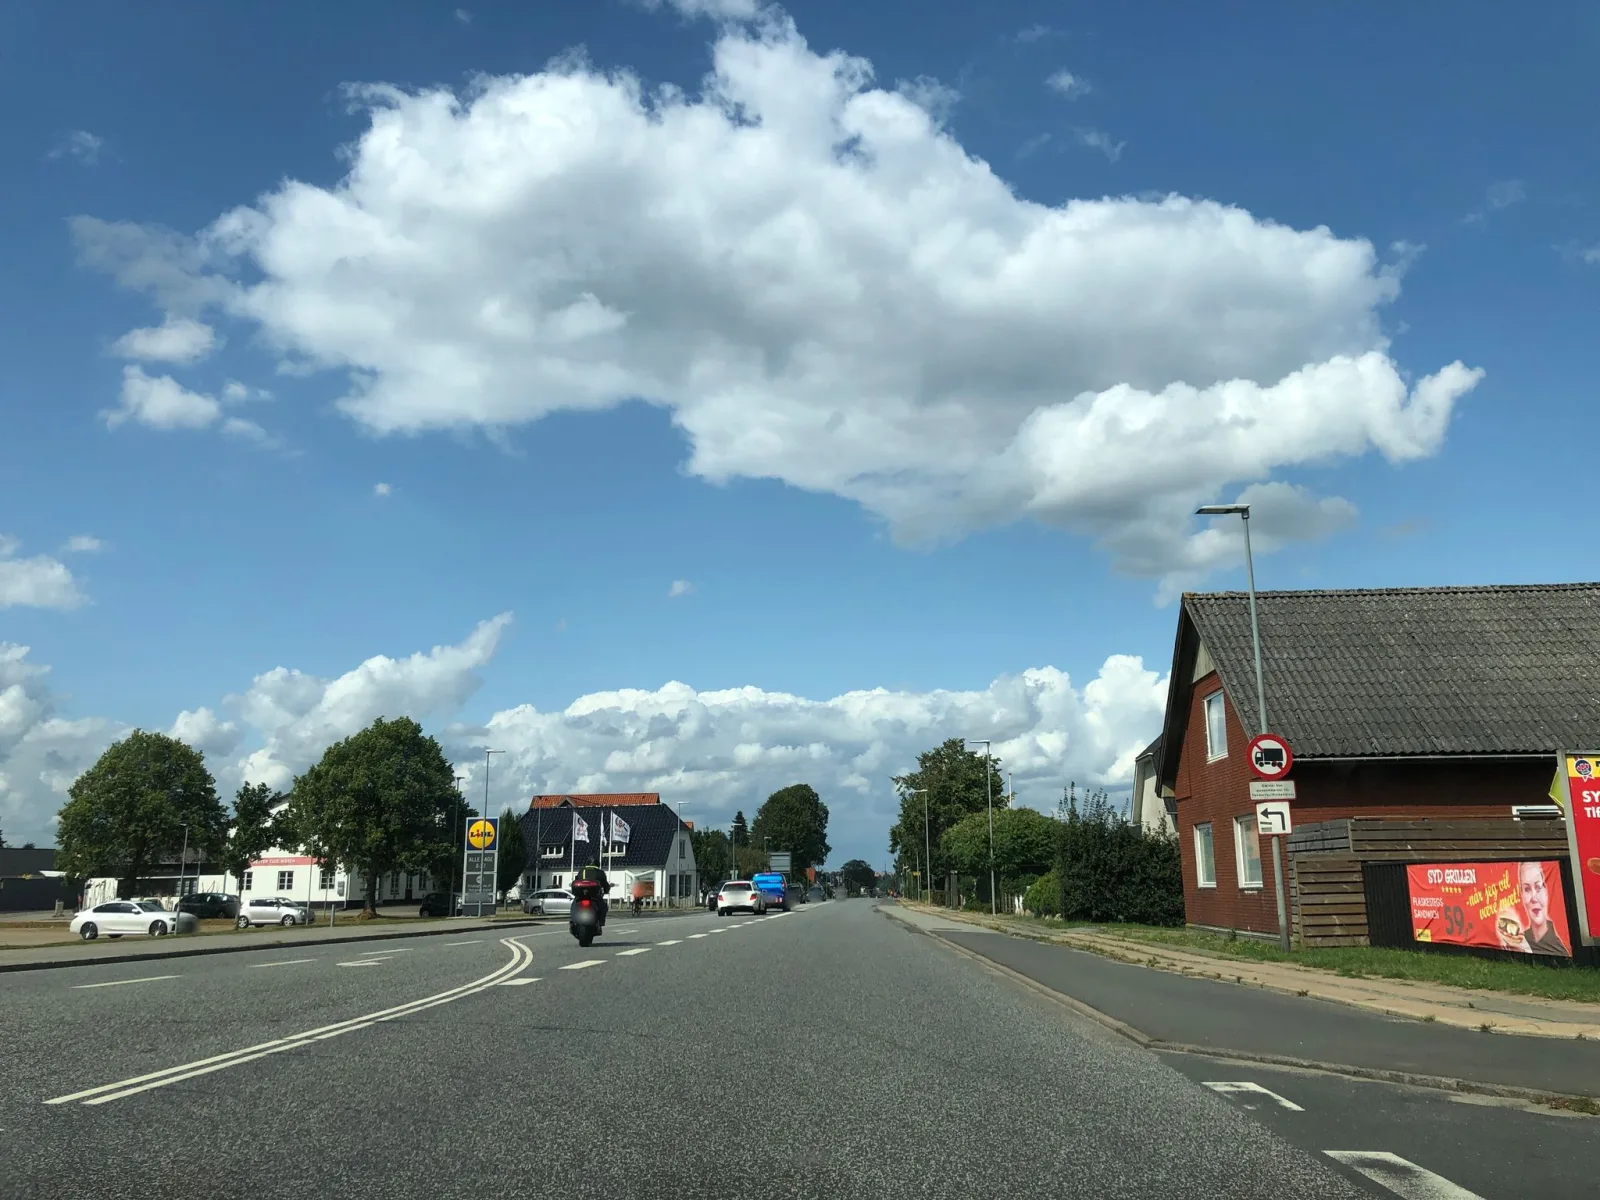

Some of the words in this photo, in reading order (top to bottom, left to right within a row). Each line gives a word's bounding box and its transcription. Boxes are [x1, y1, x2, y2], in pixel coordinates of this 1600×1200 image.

[1427, 869, 1443, 884] SYD
[1445, 869, 1476, 884] GRILLEN
[1484, 883, 1498, 904] jeg
[1499, 870, 1511, 891] vil
